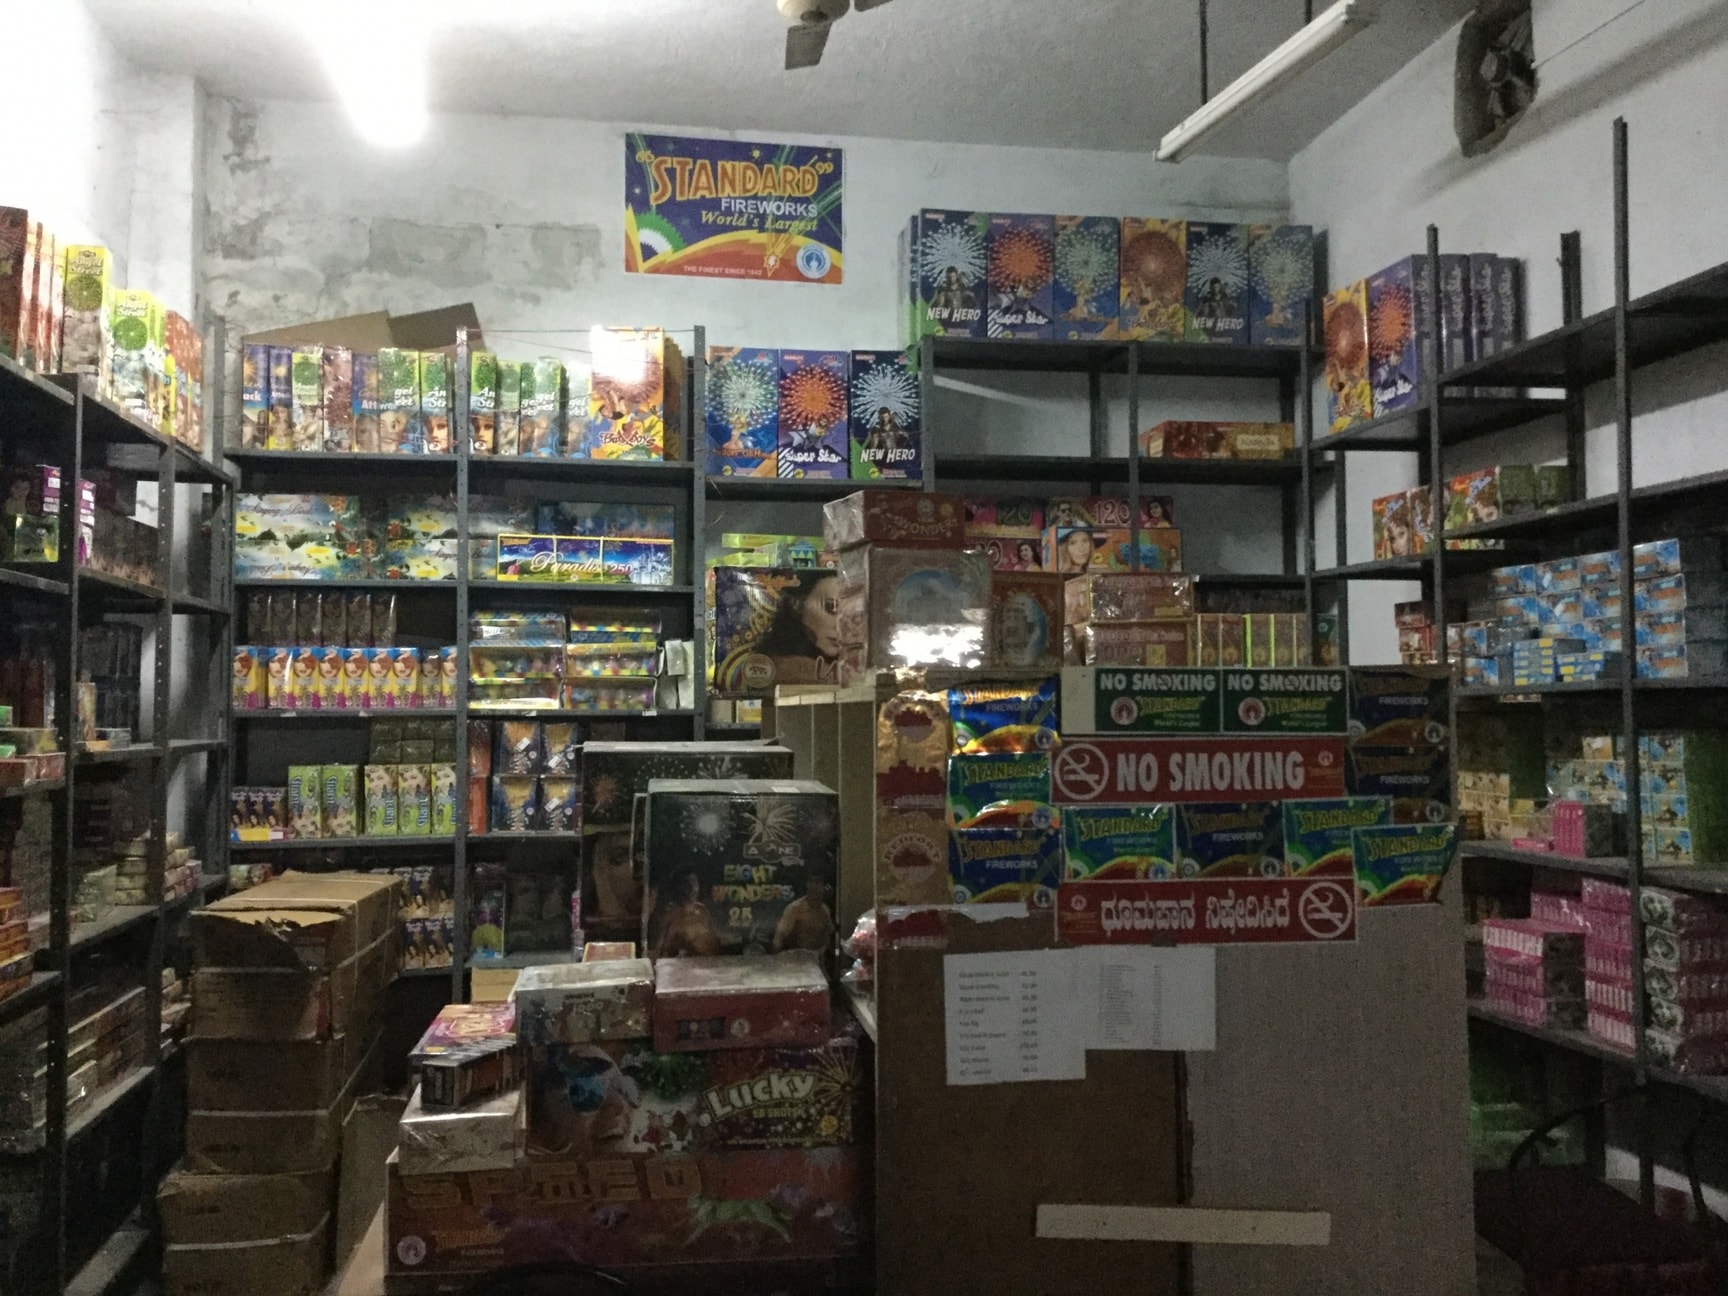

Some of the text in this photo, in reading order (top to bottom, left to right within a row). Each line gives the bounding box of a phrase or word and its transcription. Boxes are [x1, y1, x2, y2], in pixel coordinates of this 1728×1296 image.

[720, 198, 818, 218] FIREWORKS
[700, 210, 759, 228] World's
[926, 307, 981, 322] NEW HERO
[1192, 317, 1215, 331] NEW
[1215, 318, 1244, 331] HERO
[784, 449, 816, 464] Super
[816, 449, 842, 463] Star
[860, 449, 916, 463] NEW HERO
[1094, 499, 1130, 526] 120
[610, 563, 634, 574] 250
[1100, 673, 1216, 691] NO SMOKING
[1227, 673, 1343, 692] NO SMOKING
[1116, 752, 1159, 792] NO
[1168, 750, 1305, 792] SMOKING
[1212, 831, 1264, 842] FIREWORKS
[986, 859, 1039, 870] FIREWORKS
